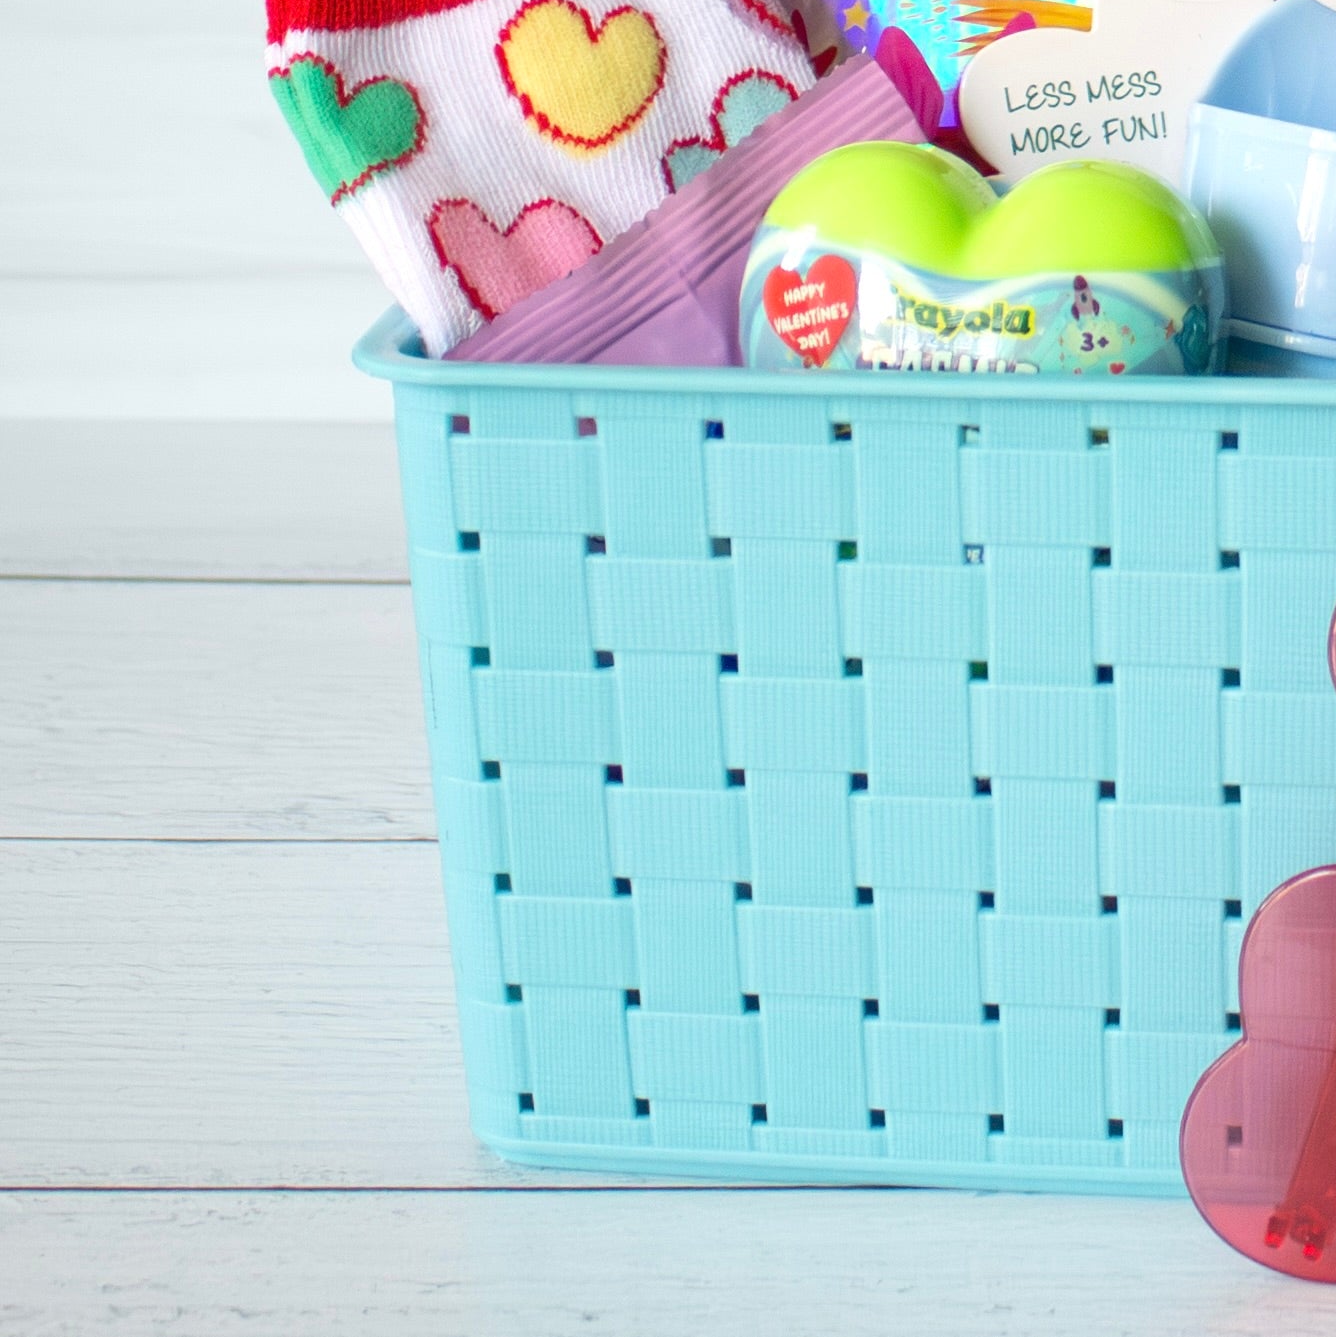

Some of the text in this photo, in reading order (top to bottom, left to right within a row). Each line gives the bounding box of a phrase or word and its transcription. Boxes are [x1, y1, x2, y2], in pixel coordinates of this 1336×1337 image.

[1004, 70, 1163, 115] LESS MESS
[1010, 110, 1169, 156] MORE FUN!
[783, 281, 826, 307] HAPPY
[891, 289, 1032, 338] rayola
[797, 327, 831, 351] DAY!
[1079, 332, 1110, 352] 3+
